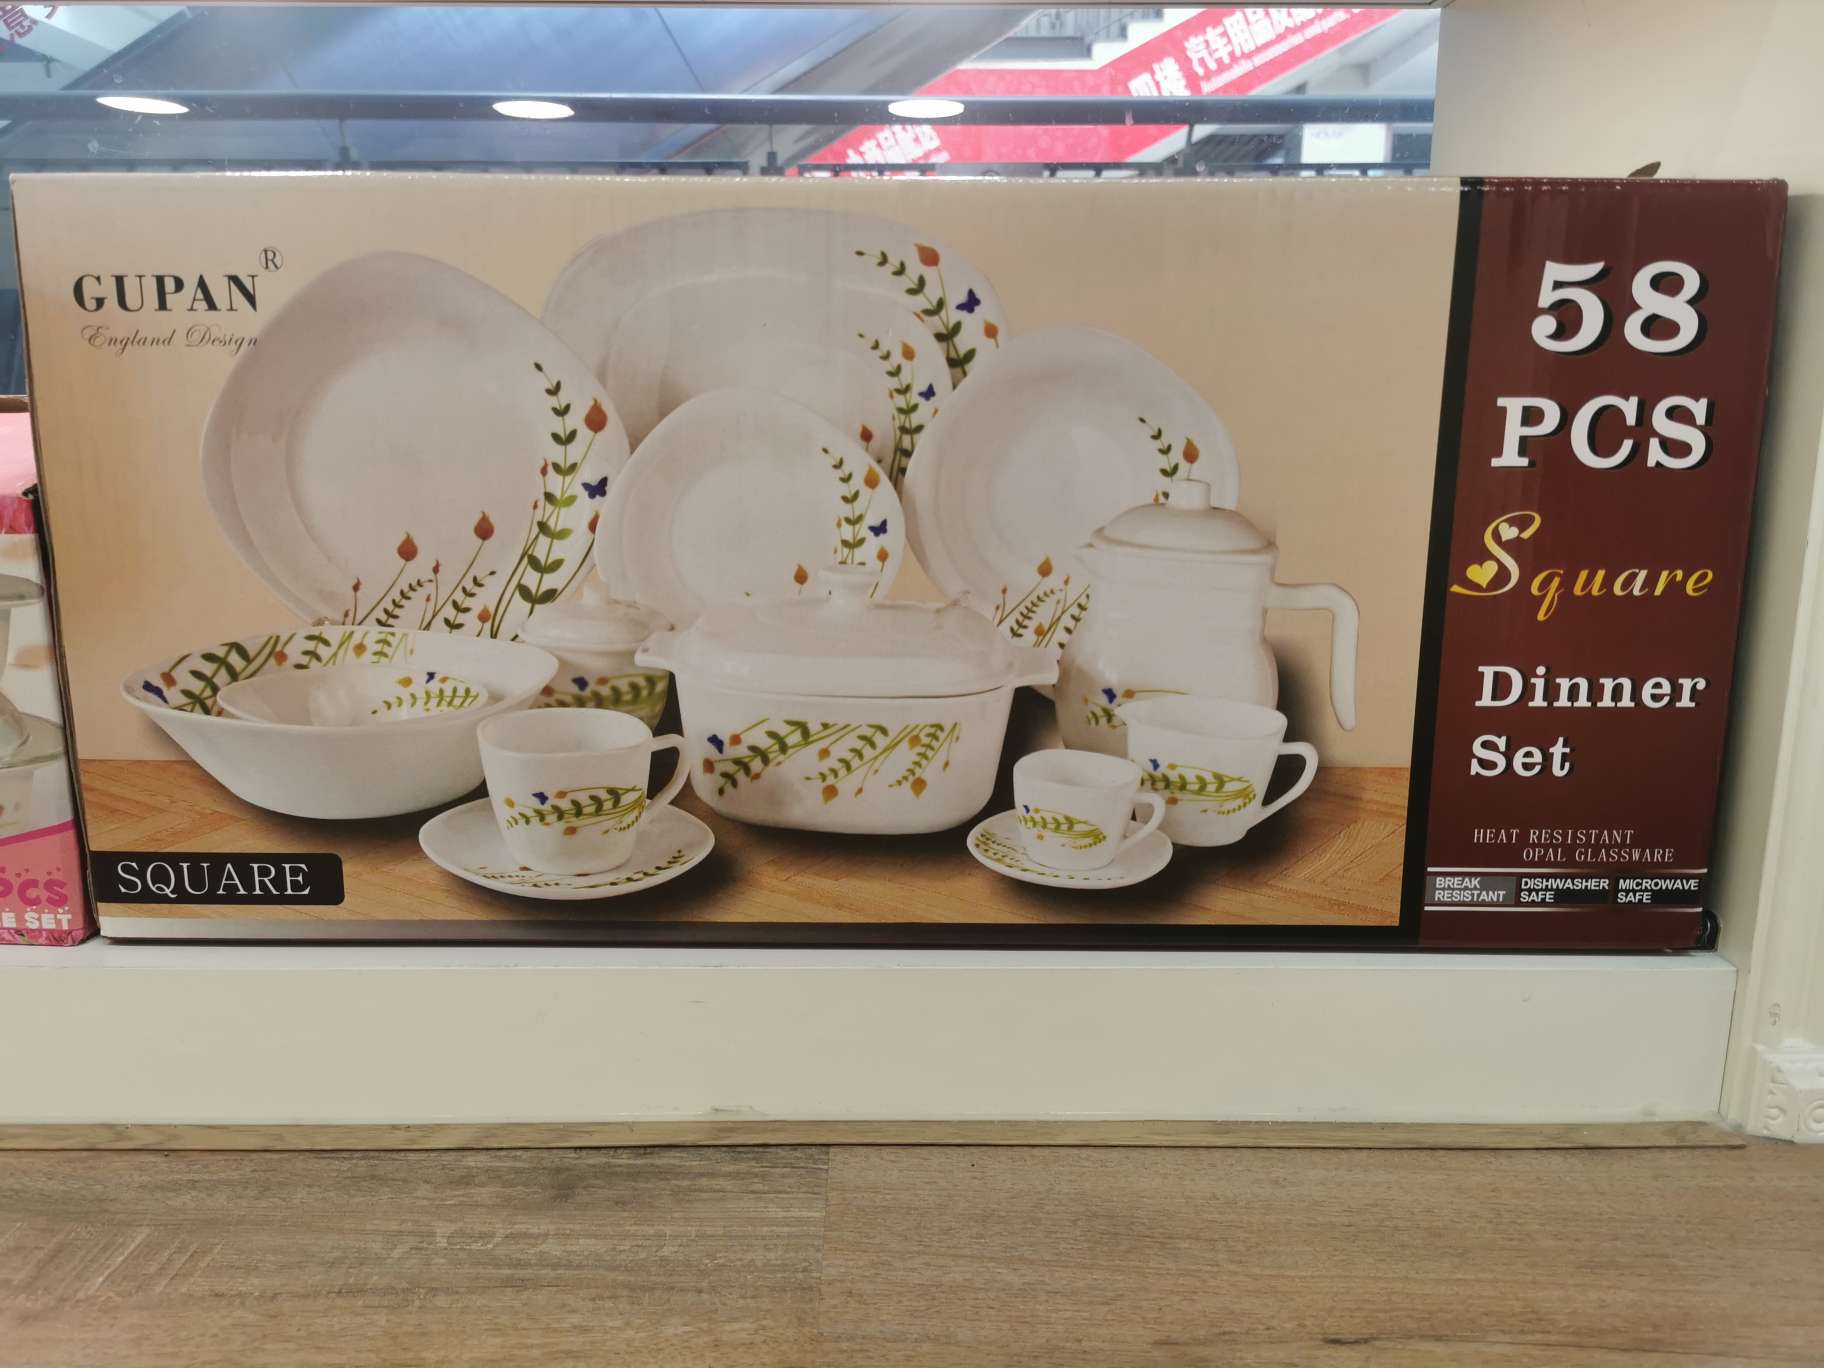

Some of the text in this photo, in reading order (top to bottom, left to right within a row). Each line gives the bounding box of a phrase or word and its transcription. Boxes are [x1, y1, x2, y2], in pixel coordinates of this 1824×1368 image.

[73, 273, 259, 313] GUPAN
[1531, 260, 1704, 354] 58
[81, 323, 259, 357] England Design
[1490, 395, 1711, 470] PCS
[1449, 511, 1714, 621] Square
[1474, 665, 1708, 709] Dinner
[1470, 734, 1572, 777] Set
[1473, 828, 1635, 845] HEAT RESISTANT
[1523, 848, 1675, 863] OPAL GLASSWARE
[116, 860, 311, 898] SQUARE
[1435, 877, 1481, 889] BREAK
[1520, 878, 1609, 890] DISHWASHER
[1618, 879, 1700, 891] MICROWAVE
[1434, 890, 1506, 902] RESISTANT
[1519, 891, 1555, 903] SAFE
[1617, 892, 1652, 904] SAFE
[24, 911, 72, 930] SET
